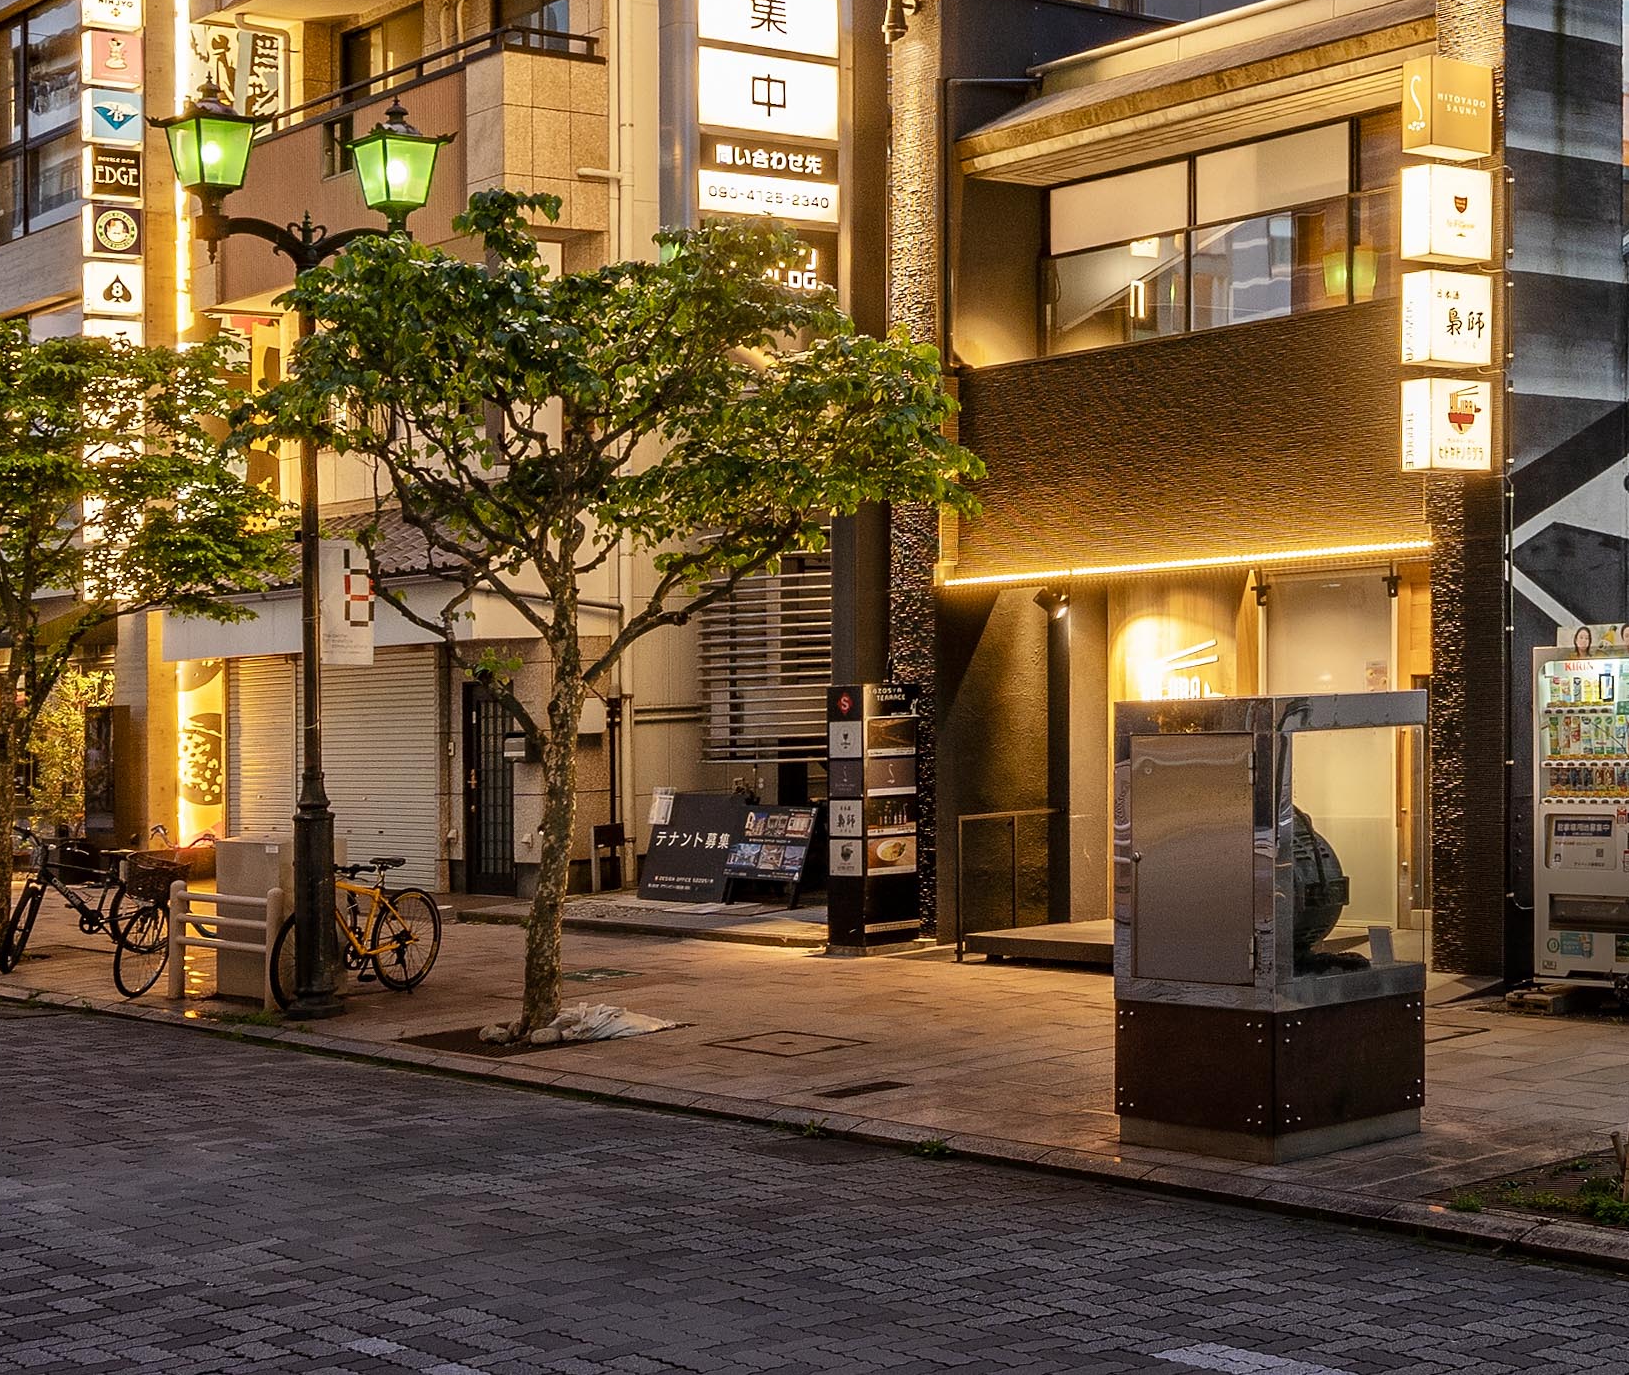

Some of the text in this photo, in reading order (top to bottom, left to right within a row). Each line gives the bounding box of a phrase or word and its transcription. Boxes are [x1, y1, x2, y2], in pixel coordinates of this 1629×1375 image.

[1437, 92, 1486, 108] HITOYADO
[1446, 104, 1477, 116] SAUNA
[715, 144, 823, 174] 問い合わせ先
[94, 165, 139, 186] EDGE
[1564, 661, 1594, 671] KIRIN
[655, 831, 731, 850] テナント募集
